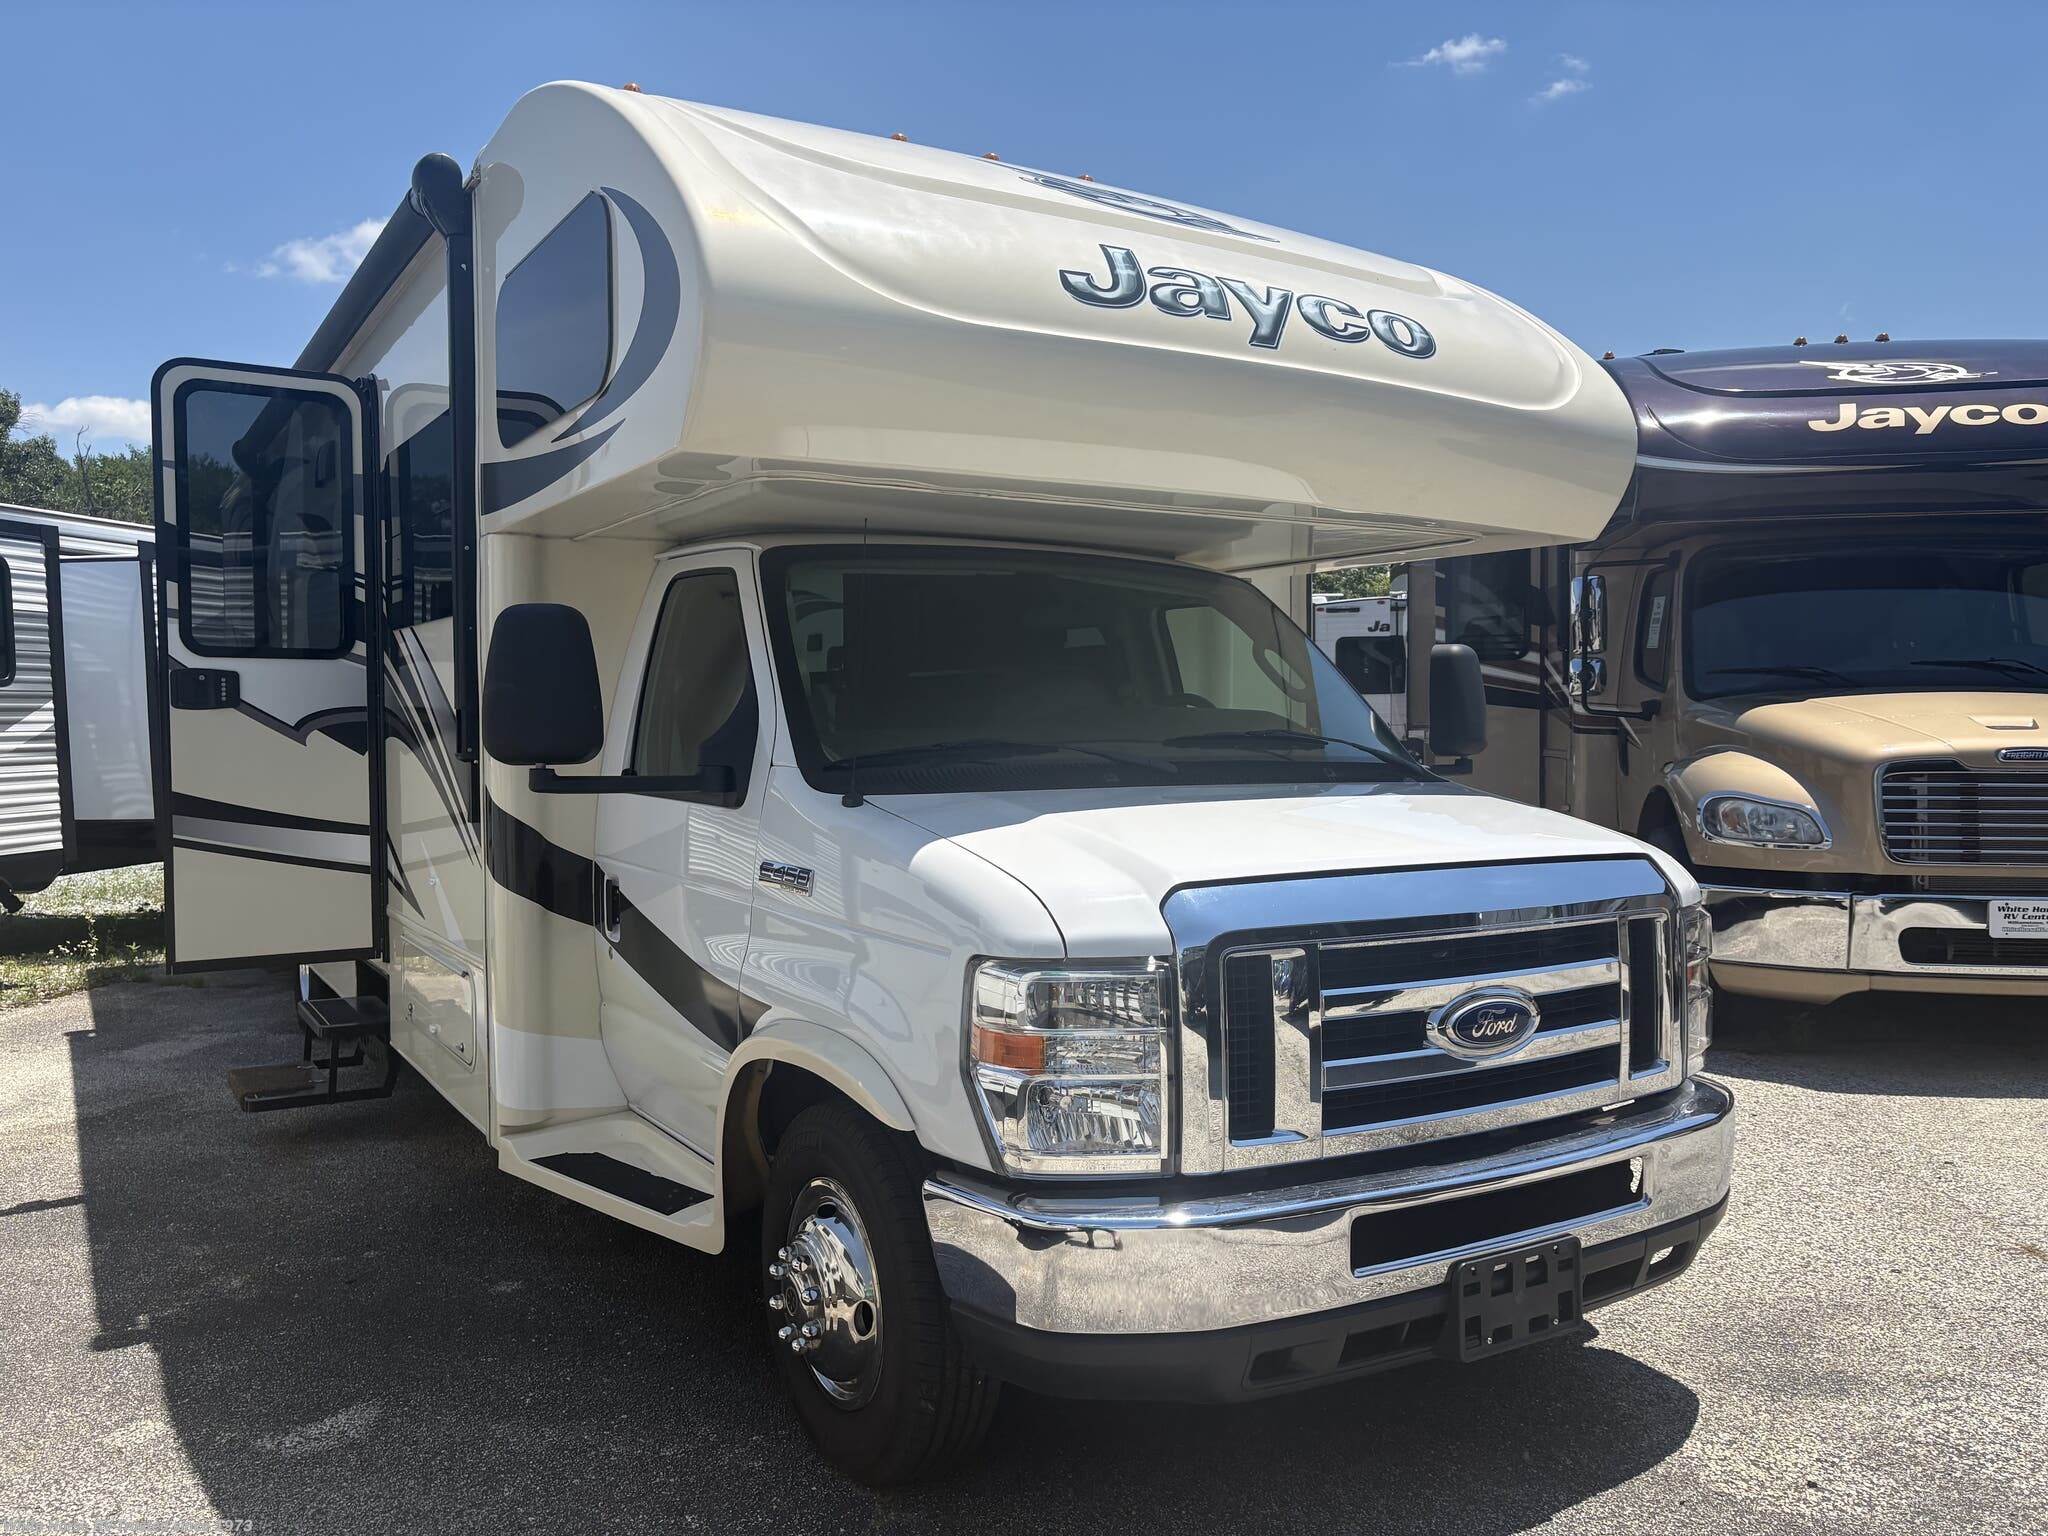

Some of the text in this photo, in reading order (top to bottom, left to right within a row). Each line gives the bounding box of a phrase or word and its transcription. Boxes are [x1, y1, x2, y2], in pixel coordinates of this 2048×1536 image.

[1058, 243, 1437, 359] Jayco
[1808, 403, 2048, 435] Jayco
[1472, 1008, 1518, 1038] Ford
